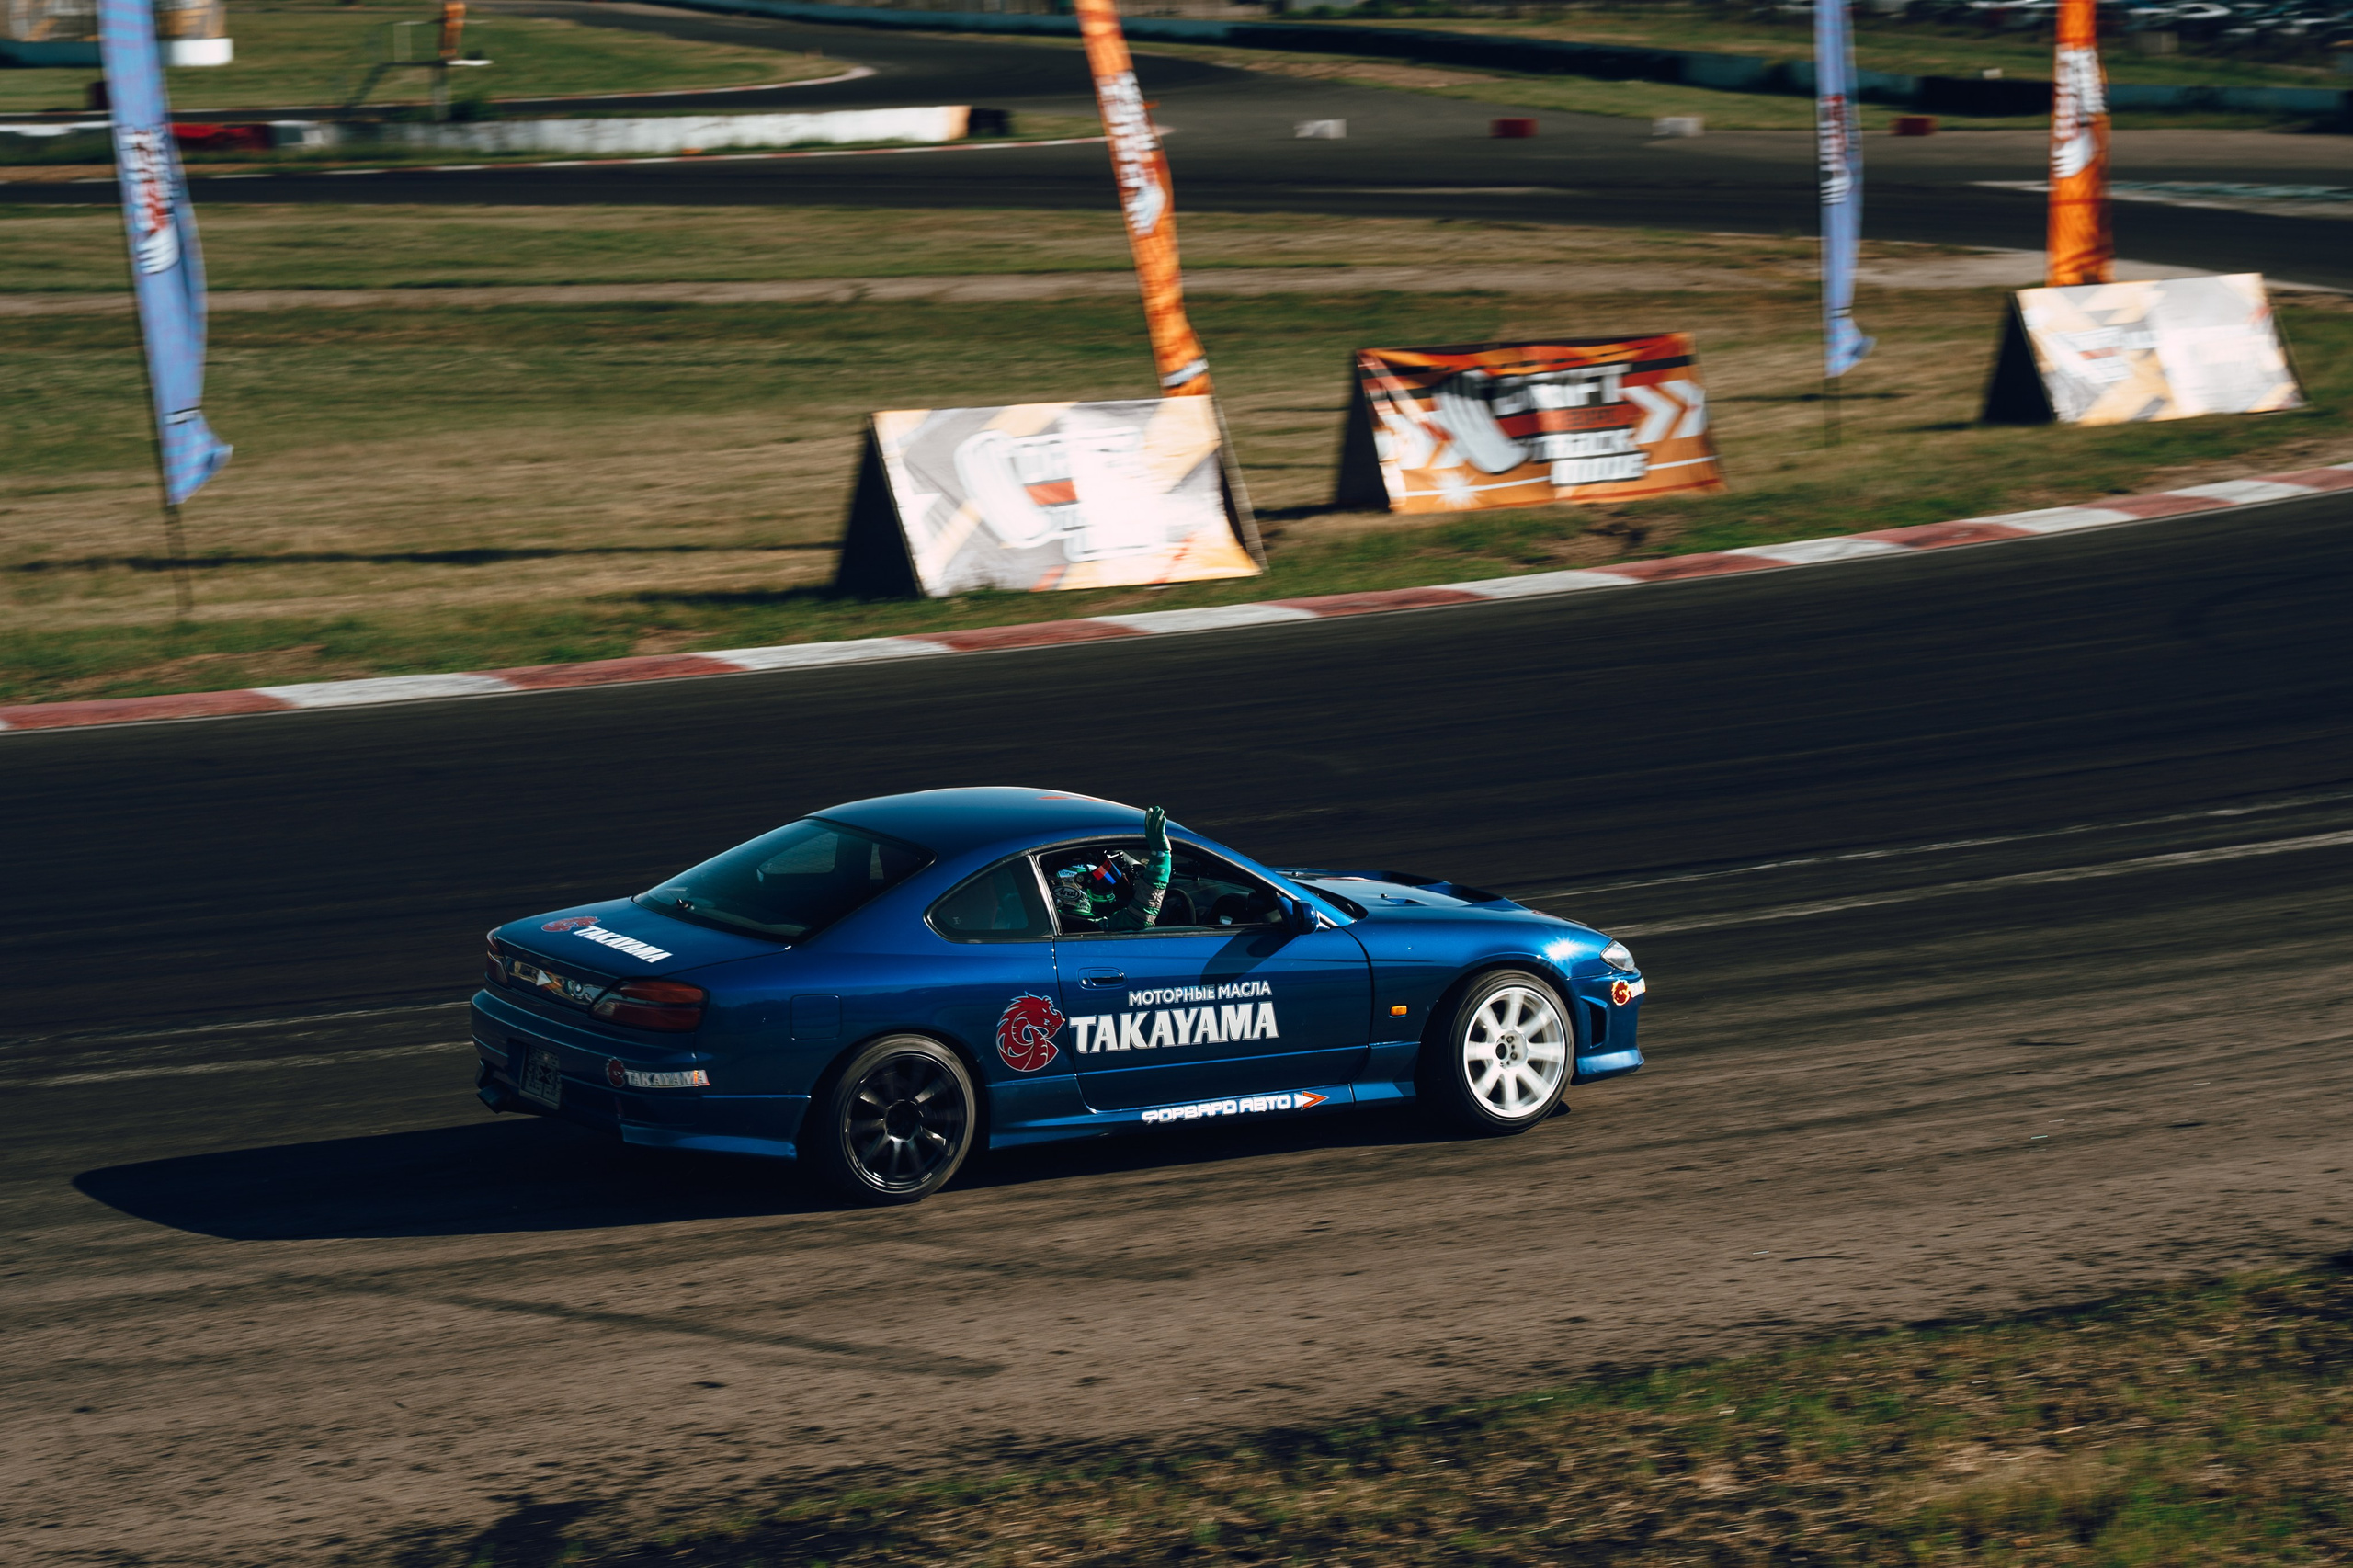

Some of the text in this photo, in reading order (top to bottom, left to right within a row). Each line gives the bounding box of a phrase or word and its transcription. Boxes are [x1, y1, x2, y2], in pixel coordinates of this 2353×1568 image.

[573, 926, 674, 963] TAKAYAMA
[1129, 980, 1273, 1007] МОТОРНЫЕ МАСЛА
[1069, 1001, 1280, 1054] TAKAYAMA
[625, 1069, 710, 1088] TAKAYAMA
[1239, 1095, 1291, 1113] АВТО
